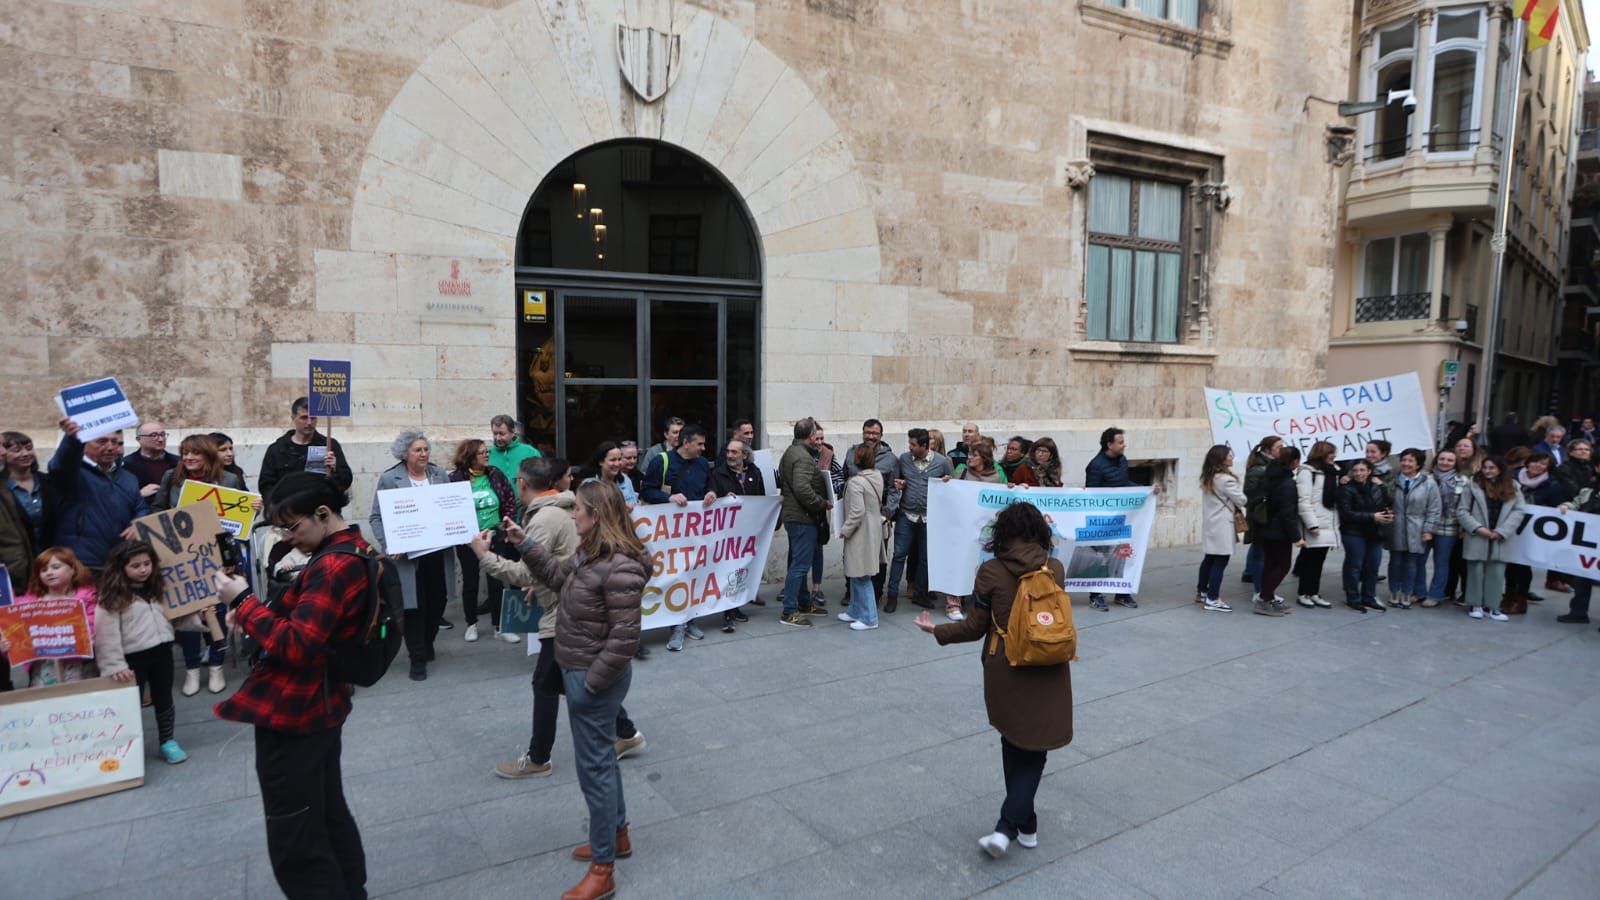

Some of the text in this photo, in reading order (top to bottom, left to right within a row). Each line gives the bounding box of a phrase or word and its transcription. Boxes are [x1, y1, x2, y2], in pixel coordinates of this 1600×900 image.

[313, 378, 346, 387] NO POT
[1247, 394, 1286, 413] CEIP
[1301, 391, 1333, 410] LA
[1343, 380, 1393, 406] PAU
[1273, 410, 1371, 437] CASINOS
[1036, 496, 1146, 509] INFRAESTRUCTURES
[136, 510, 194, 555] NO
[1089, 517, 1125, 527] MILLOR
[712, 536, 757, 564] UNA
[1579, 554, 1600, 572] V
